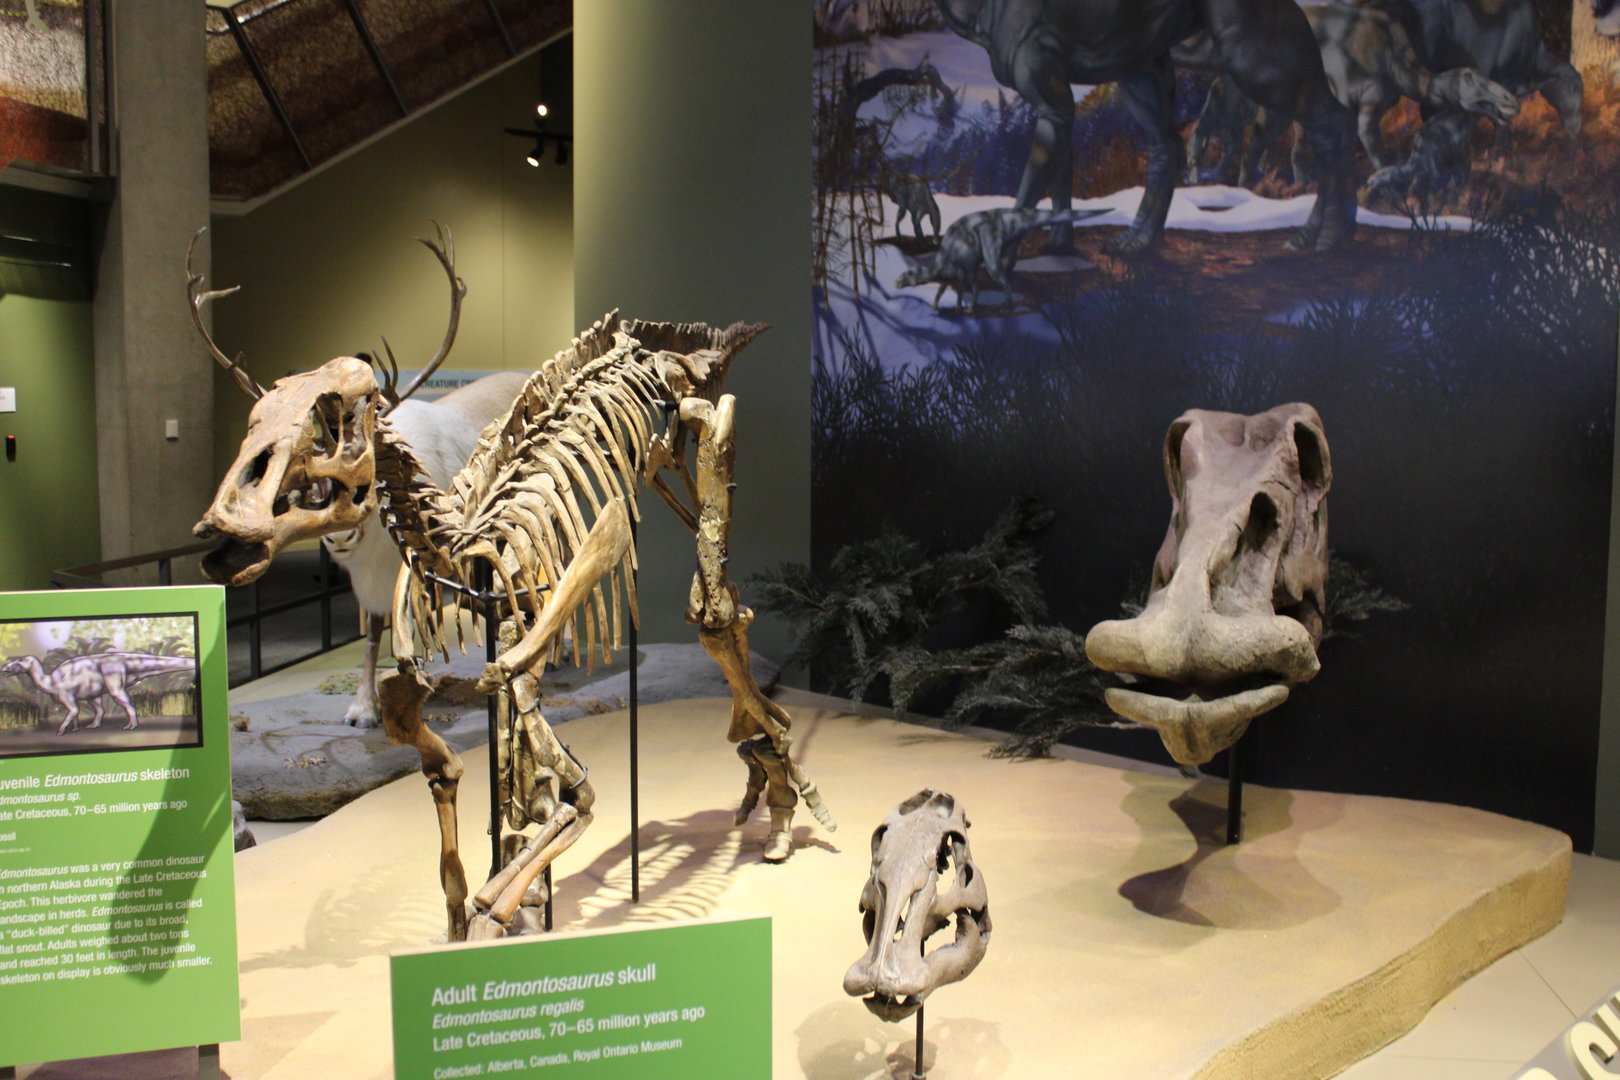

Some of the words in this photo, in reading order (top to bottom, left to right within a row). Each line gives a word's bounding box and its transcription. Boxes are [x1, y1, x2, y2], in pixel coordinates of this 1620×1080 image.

[0, 776, 40, 790] uvenile
[44, 770, 138, 786] Edmontosaurus
[140, 768, 190, 781] skeleton
[0, 793, 65, 805] dmontosaurus
[67, 792, 81, 802] sp.
[0, 812, 12, 821] ate
[16, 807, 71, 819] Cretaceous,
[74, 804, 106, 815] 70–65
[110, 803, 141, 813] million
[143, 802, 168, 812] years
[170, 800, 187, 811] ago
[0, 832, 16, 841] ossil
[0, 866, 68, 879] dmontosaurus
[70, 864, 89, 873] was
[101, 861, 120, 872] very
[123, 859, 163, 869] common
[166, 855, 205, 865] dinosaur
[0, 886, 4, 894] n
[8, 882, 47, 893] northern
[50, 880, 80, 890] Alaska
[84, 878, 113, 889] during
[116, 874, 131, 884] the
[133, 874, 153, 883] Late
[156, 870, 207, 881] Cretaceous
[31, 897, 50, 906] This
[53, 894, 96, 905] herbivore
[100, 889, 145, 901] wandered
[148, 888, 162, 896] the
[0, 913, 45, 924] andscape
[48, 911, 57, 920] in
[60, 909, 88, 919] herds.
[92, 904, 163, 916] Edmontosaurus
[165, 902, 173, 910] is
[176, 898, 202, 909] called
[72, 921, 112, 933] dinosaur
[114, 920, 131, 929] due
[134, 919, 142, 927] to
[146, 917, 157, 926] its
[160, 916, 188, 925] broad,
[16, 942, 44, 952] snout.
[48, 940, 77, 950] Adults
[80, 935, 118, 949] weighed
[122, 933, 147, 943] about
[150, 931, 167, 940] two
[169, 930, 189, 939] tons
[0, 960, 17, 969] and
[20, 956, 58, 967] reached
[61, 954, 73, 963] 30
[76, 952, 94, 962] feet
[96, 950, 105, 960] in
[108, 950, 139, 960] length.
[141, 946, 159, 956] The
[161, 943, 196, 955] juvenile
[0, 973, 40, 984] skeleton
[43, 972, 54, 980] on
[58, 967, 90, 979] display
[93, 965, 101, 975] is
[103, 962, 147, 975] obviously
[149, 960, 175, 970] much
[177, 957, 212, 967] smaller.
[431, 986, 478, 1007] Adult
[483, 970, 614, 1001] Edmontosaurus
[618, 963, 657, 985] skull
[432, 1004, 536, 1030] Edmontosaurus
[540, 998, 584, 1018] regalis
[433, 1035, 463, 1052] Late
[467, 1025, 545, 1048] Cretaceous,
[549, 1021, 594, 1037] 70–65
[598, 1015, 640, 1031] million
[644, 1010, 678, 1029] years
[682, 1007, 706, 1022] ago
[434, 1064, 484, 1080] Collected:
[487, 1058, 526, 1074] Alberta,
[530, 1053, 570, 1068] Canada,
[573, 1048, 600, 1064] Royal
[602, 1042, 638, 1058] Ontario
[641, 1038, 682, 1052] Museum
